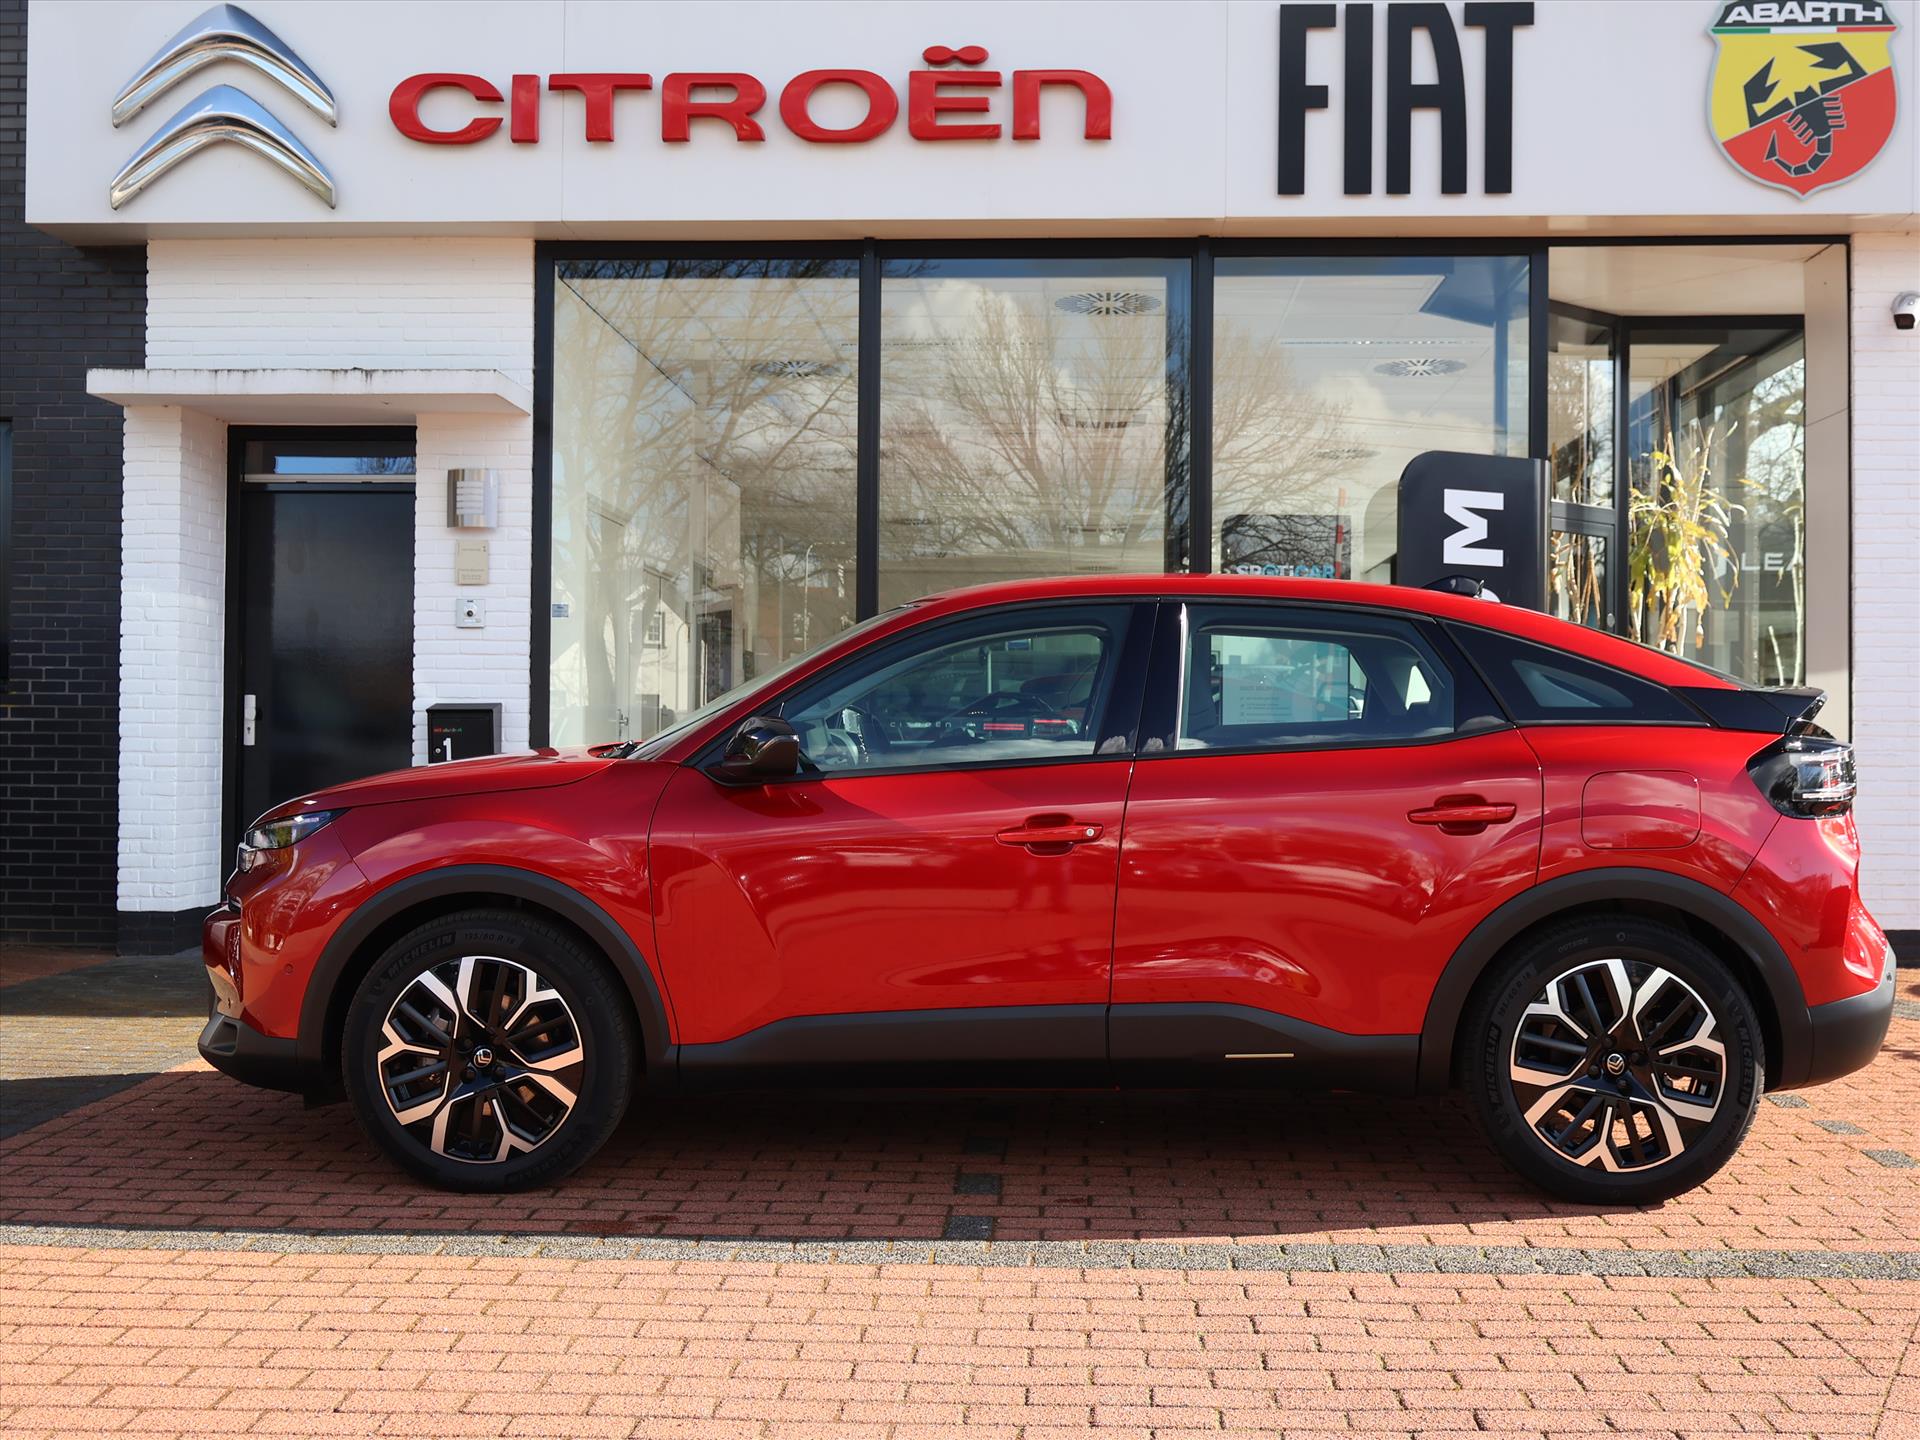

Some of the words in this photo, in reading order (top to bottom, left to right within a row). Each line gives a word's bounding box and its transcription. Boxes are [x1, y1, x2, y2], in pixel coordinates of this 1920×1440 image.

[1724, 1, 1883, 23] ABARTH
[1277, 2, 1535, 195] FIAT
[443, 737, 452, 761] 1
[386, 933, 454, 978] MICHELIN
[1484, 1025, 1500, 1104] MICHELIN
[1738, 1026, 1753, 1105] MICHELIN
